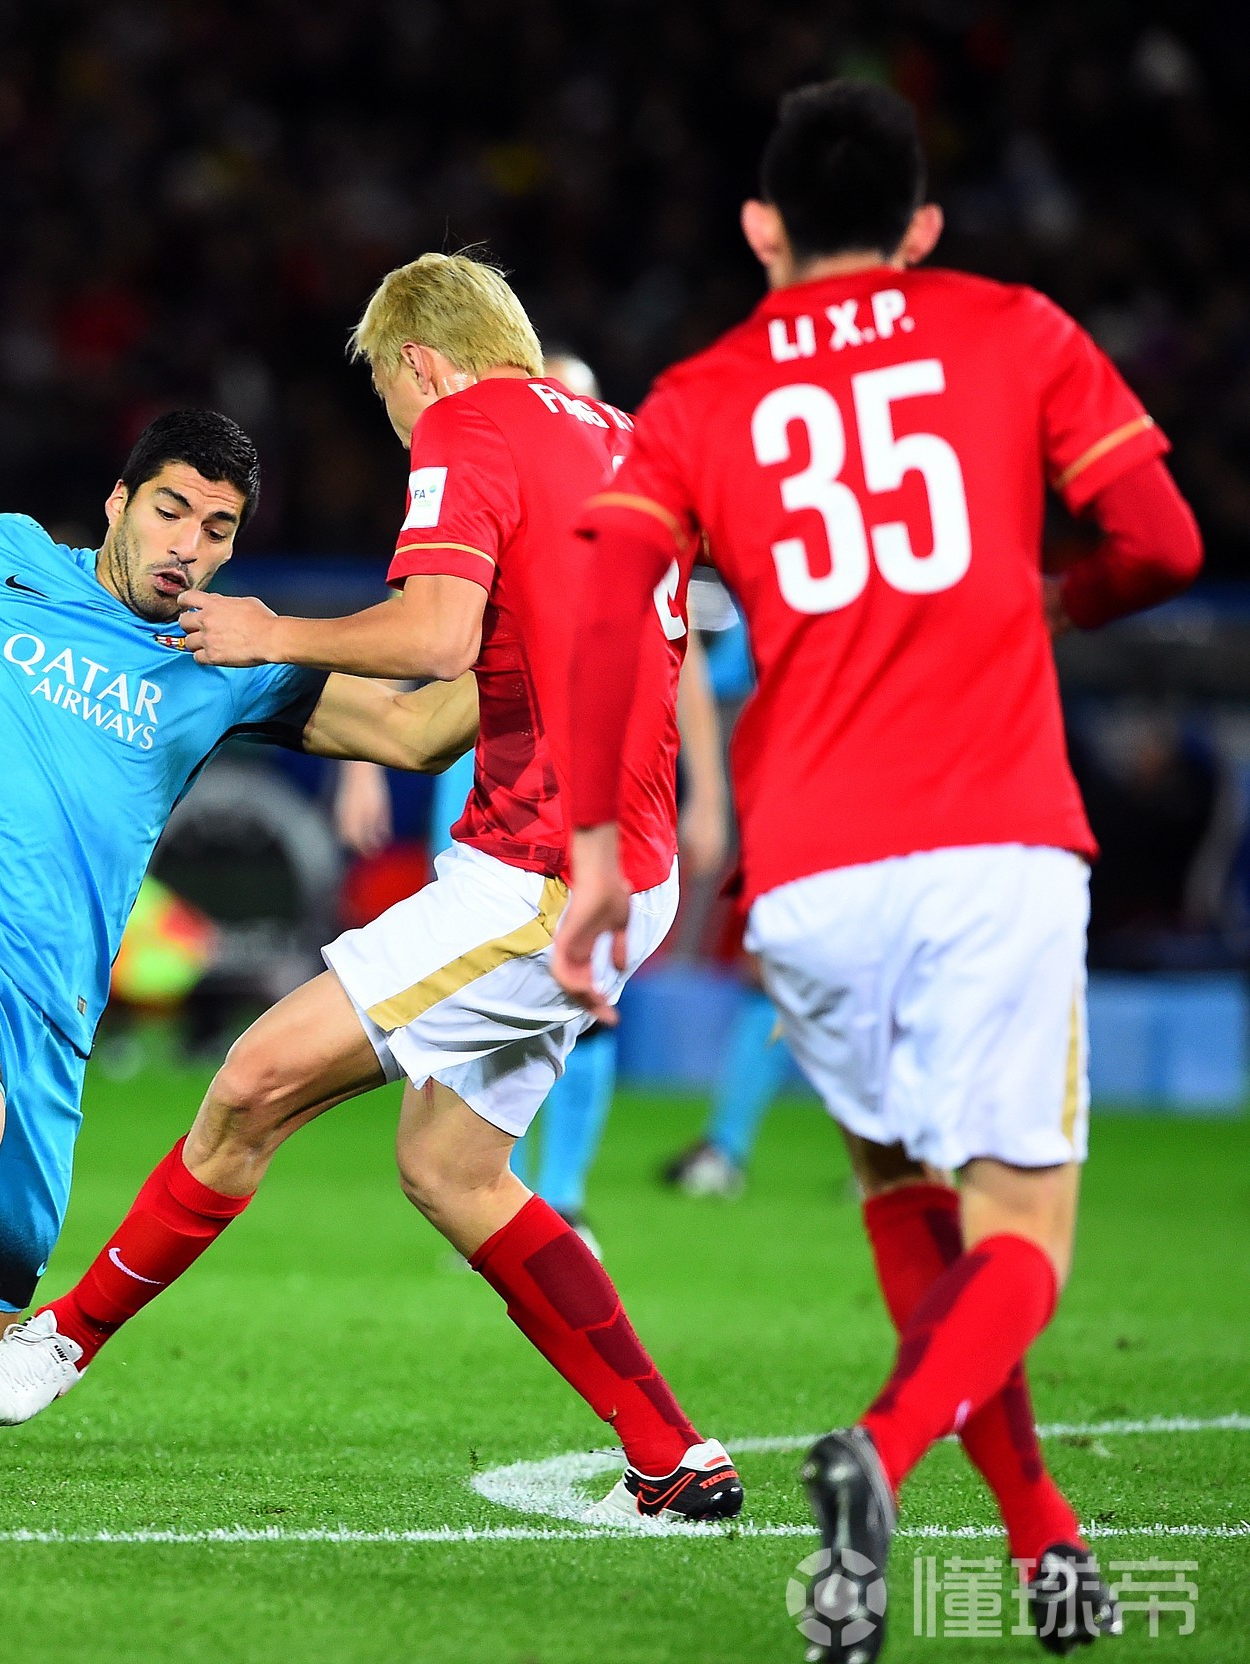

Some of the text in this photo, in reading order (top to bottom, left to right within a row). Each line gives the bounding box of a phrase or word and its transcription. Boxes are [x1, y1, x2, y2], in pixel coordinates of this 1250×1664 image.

[768, 288, 916, 363] LI X.P.
[751, 358, 972, 615] 35
[3, 633, 163, 724] QATAR
[30, 677, 157, 749] AIRWAYS
